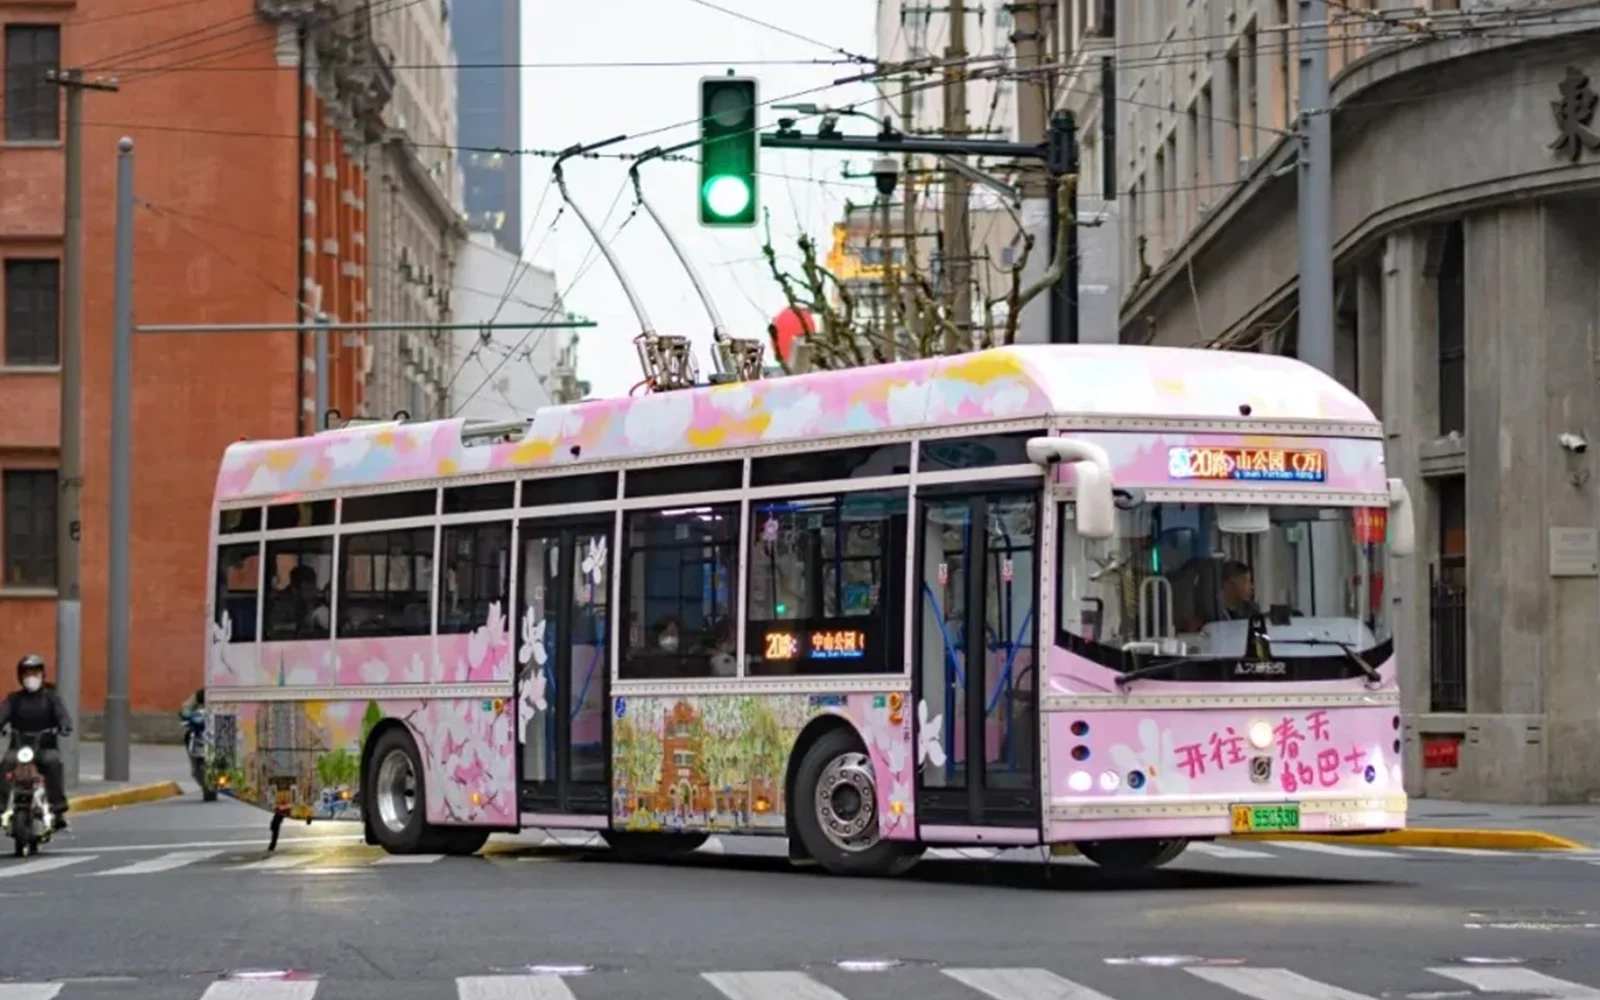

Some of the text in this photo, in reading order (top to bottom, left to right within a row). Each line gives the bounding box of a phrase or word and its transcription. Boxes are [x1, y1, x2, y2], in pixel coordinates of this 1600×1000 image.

[1547, 65, 1600, 162] 東
[1174, 710, 1330, 779] 开往 春天
[1280, 746, 1366, 793] 的巴士
